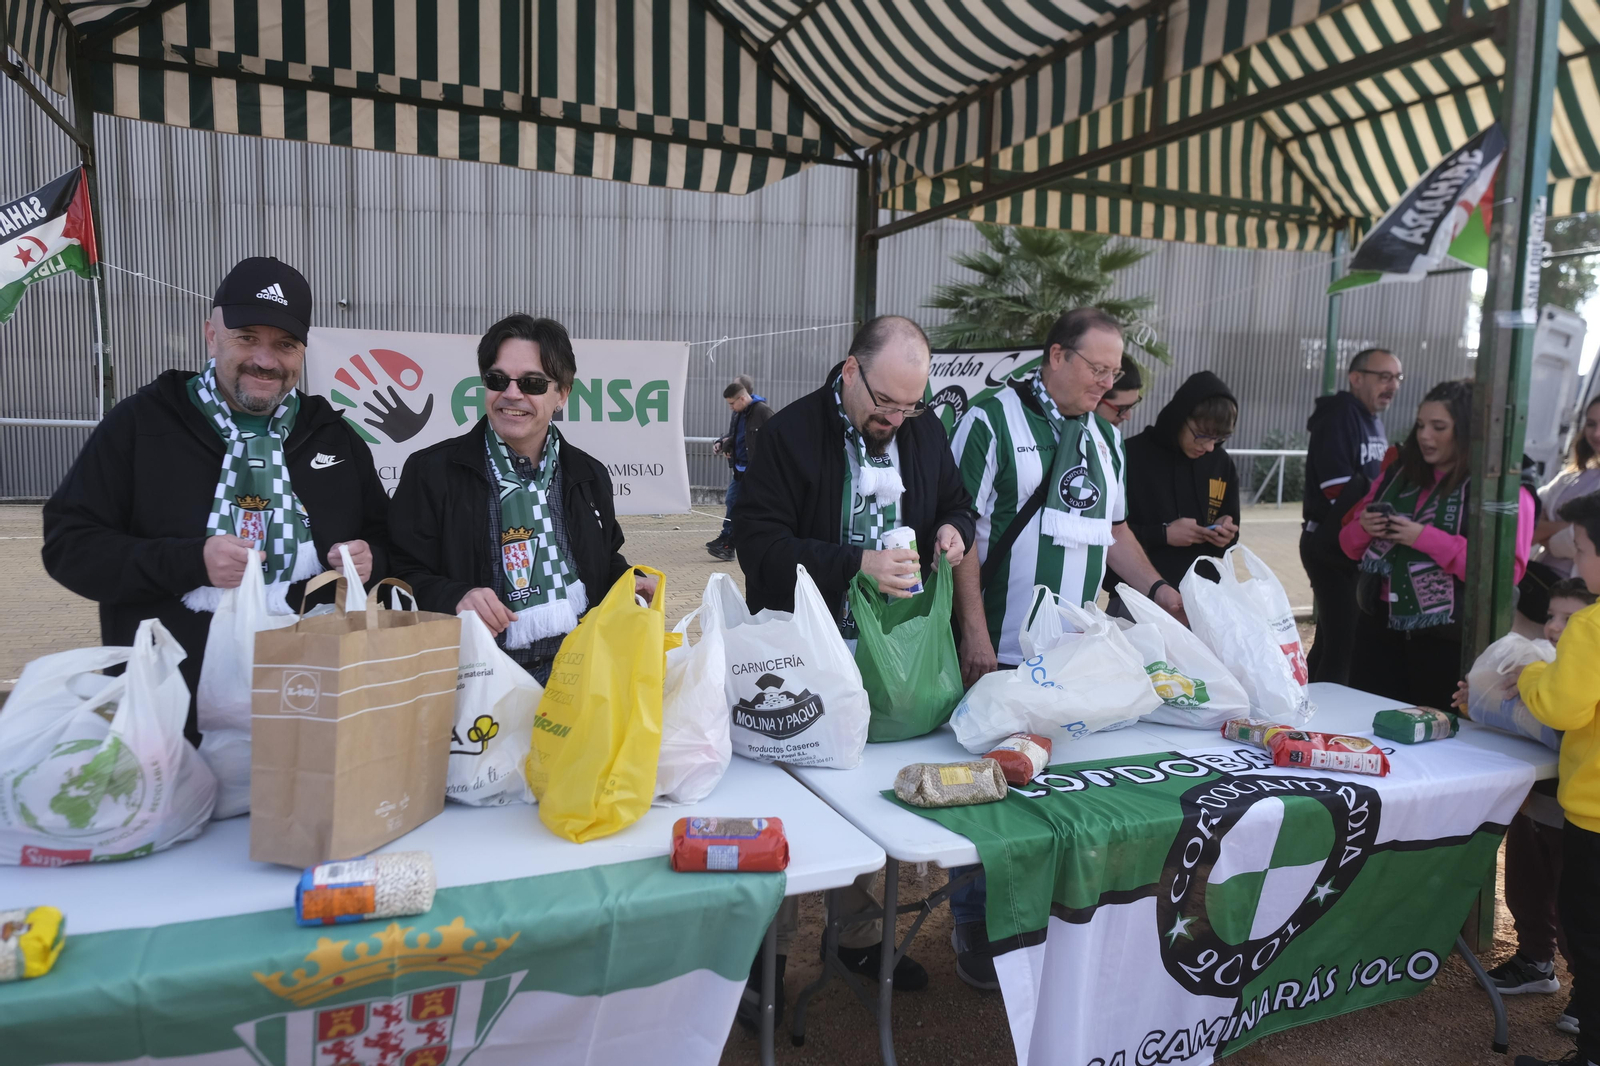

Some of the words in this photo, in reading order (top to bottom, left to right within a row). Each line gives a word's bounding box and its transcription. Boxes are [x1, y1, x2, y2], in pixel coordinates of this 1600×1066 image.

[256, 291, 289, 306] adidas
[451, 376, 670, 427] ANSA
[316, 452, 337, 463] NIKE
[606, 463, 664, 477] AMISTAD
[1069, 497, 1088, 507] 2001
[507, 586, 541, 601] 1954
[732, 654, 805, 675] CARNICERÍA
[464, 669, 494, 679] material
[735, 709, 775, 731] MOLINA
[778, 716, 787, 731] Y
[787, 701, 818, 729] PAQUI
[748, 744, 785, 753] Productos
[785, 741, 820, 752] Caseros
[1177, 921, 1301, 986] 2001
[1136, 965, 1341, 1066] CAMINARÁS
[1346, 949, 1441, 994] SOLO
